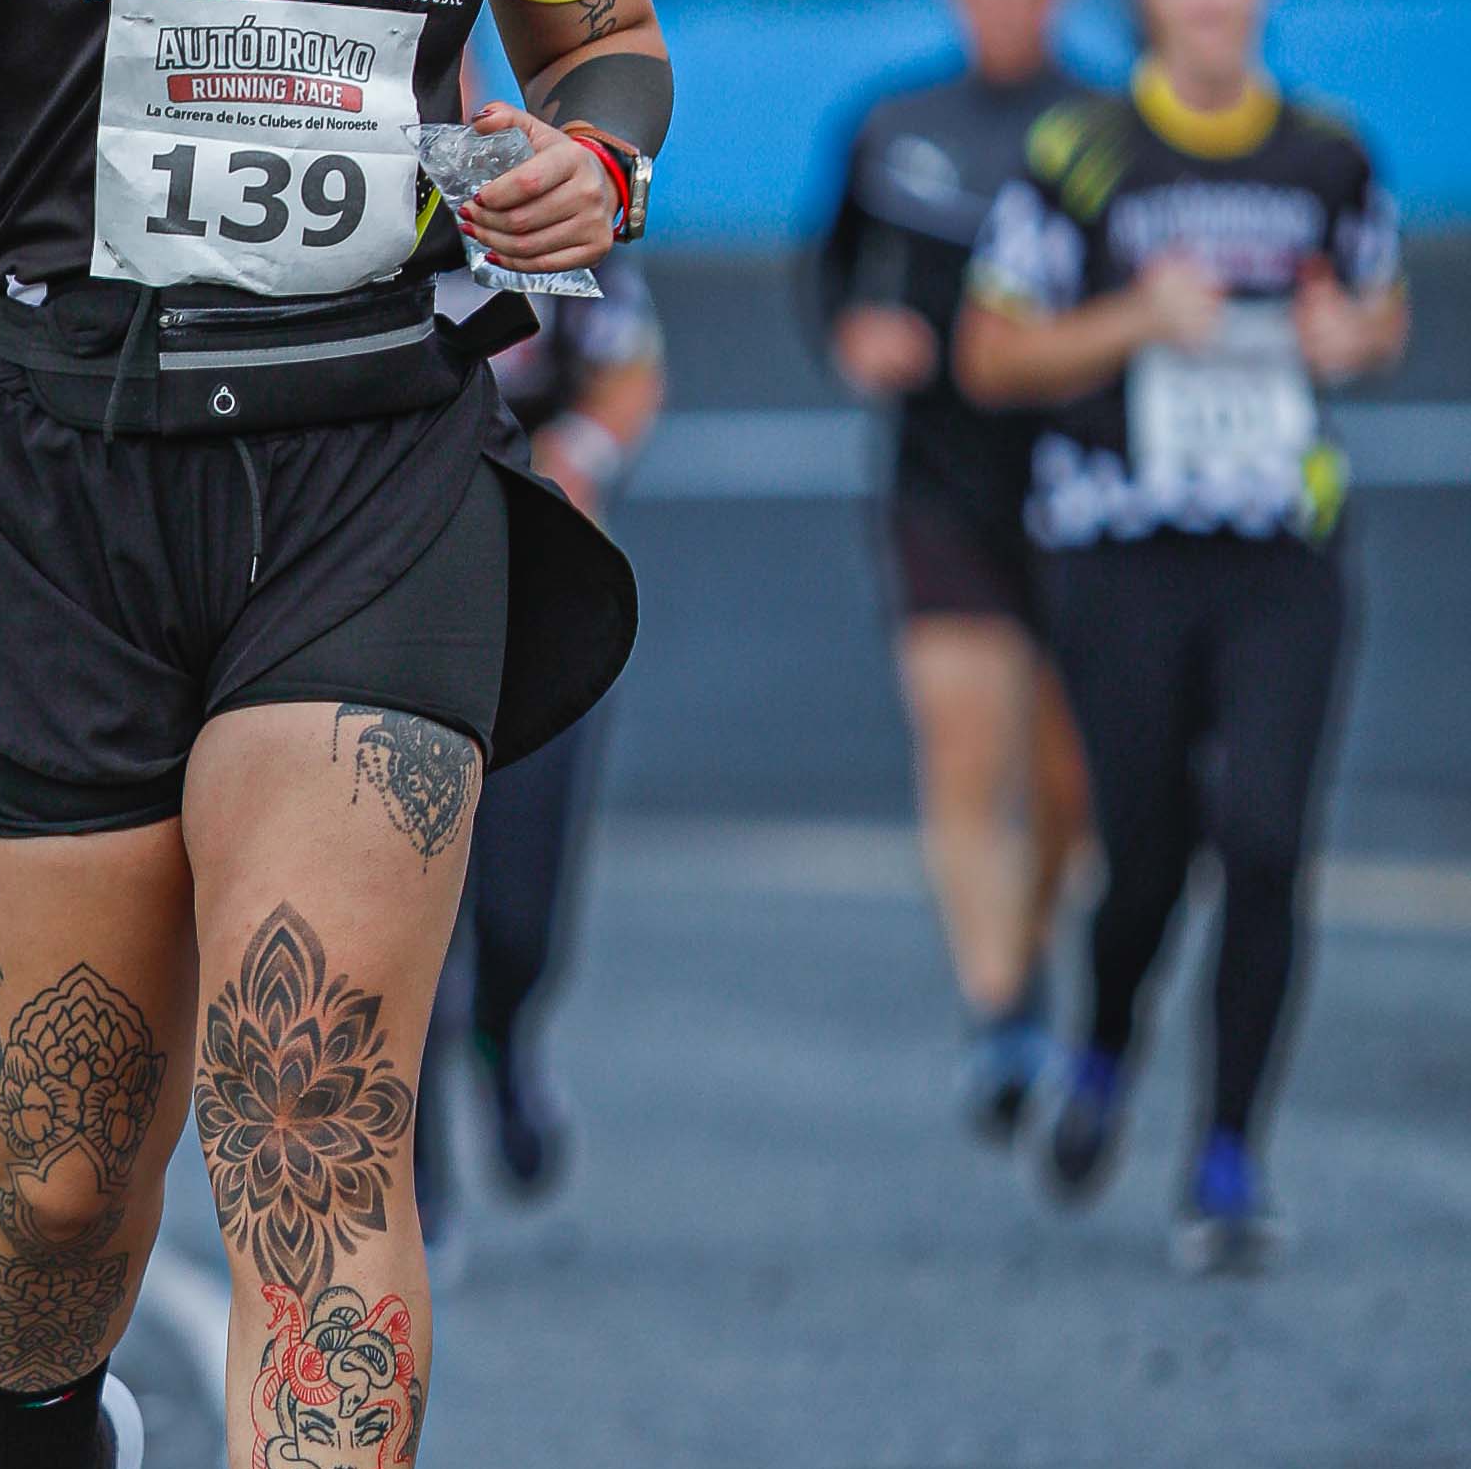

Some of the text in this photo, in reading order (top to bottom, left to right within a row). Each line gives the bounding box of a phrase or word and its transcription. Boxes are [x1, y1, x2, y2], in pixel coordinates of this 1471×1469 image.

[155, 15, 376, 83] AUTÓDROMO
[191, 77, 343, 107] RUNNING RACE
[146, 103, 378, 131] La Carrera de los Clubes del Noroeste
[145, 143, 367, 248] 139
